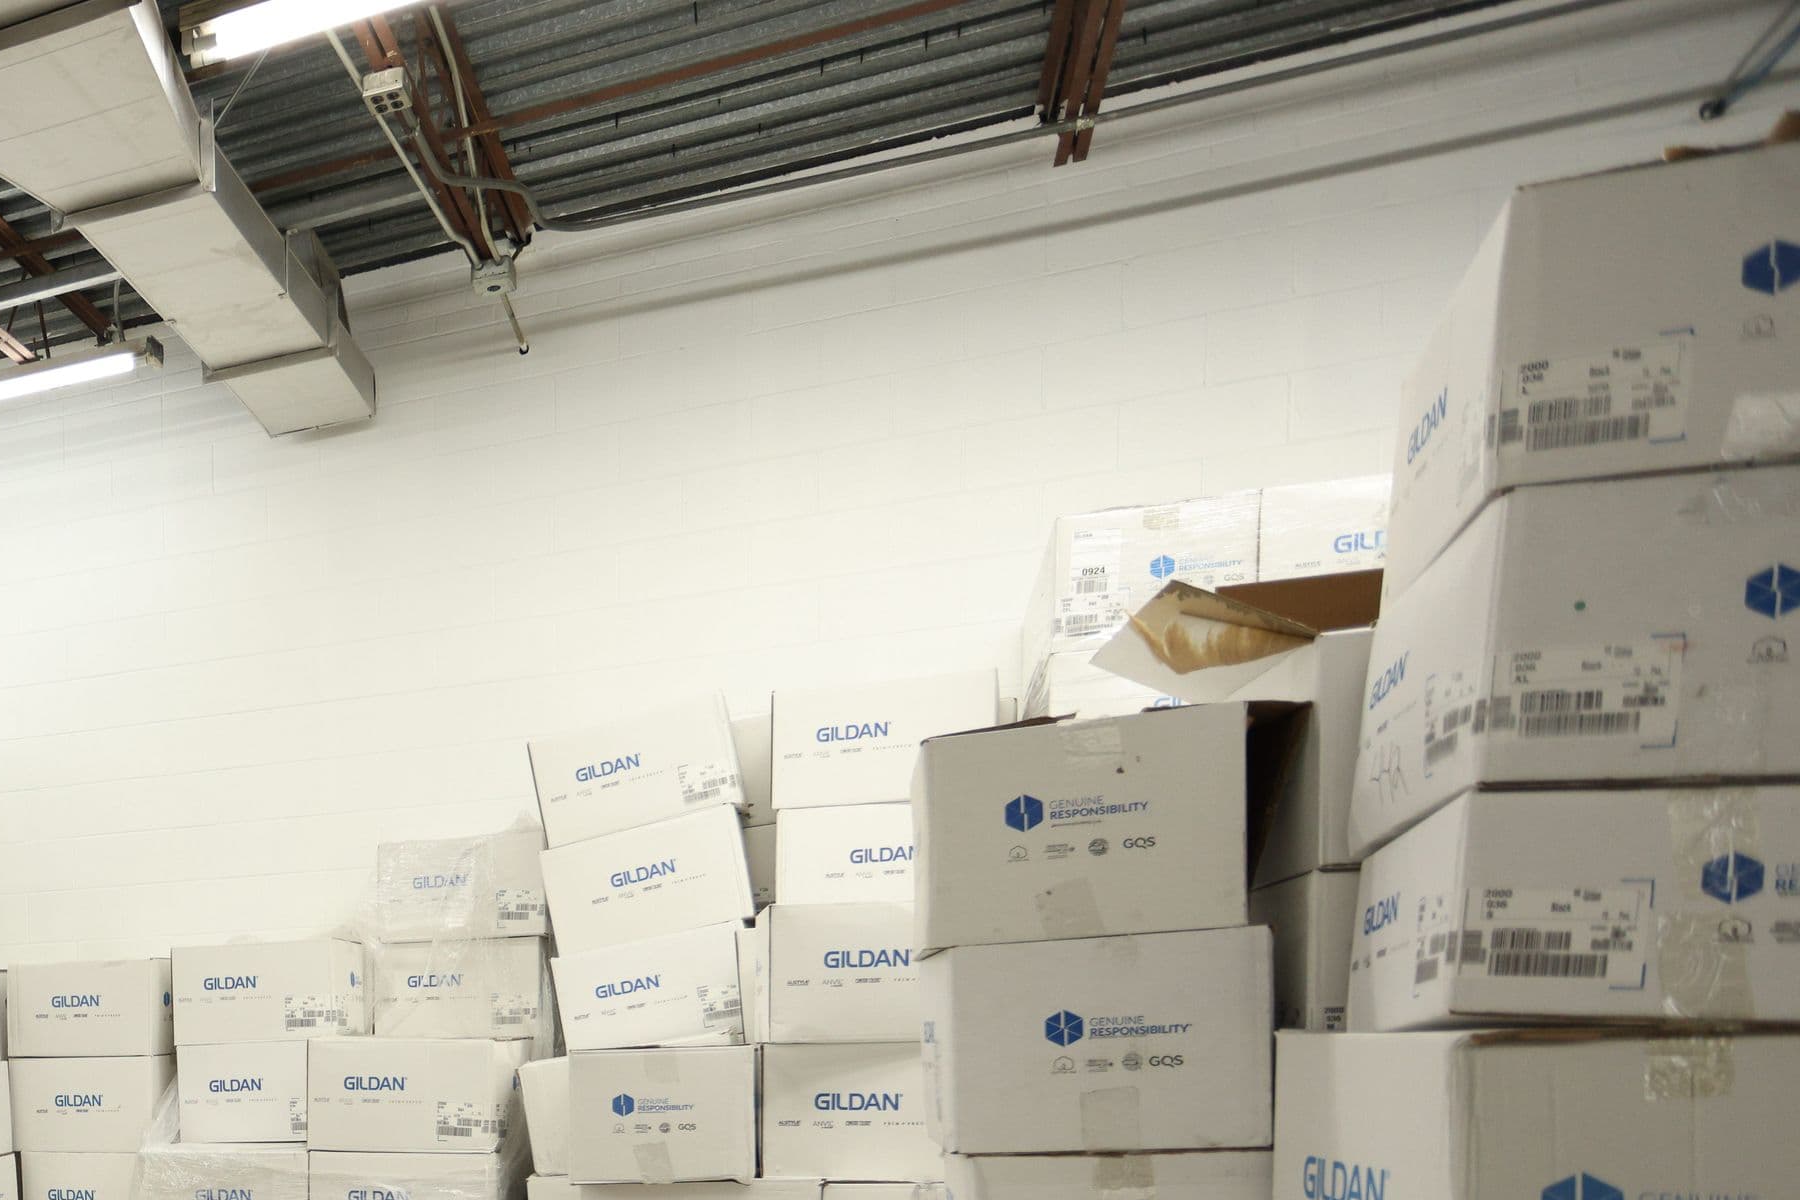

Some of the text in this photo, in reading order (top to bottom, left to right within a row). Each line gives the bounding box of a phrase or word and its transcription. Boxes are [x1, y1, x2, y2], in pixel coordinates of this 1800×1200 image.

[1082, 565, 1105, 576] 0924
[816, 721, 888, 744] GILDAN
[575, 752, 641, 783] GILDAN
[1049, 796, 1104, 808] GENUINE
[1050, 802, 1148, 820] RESPONSIBILITY
[610, 860, 676, 889] GILDAN
[203, 976, 257, 991] GILDAN
[594, 976, 660, 1000] GILDAN
[51, 994, 100, 1008] GILDAN
[1090, 1016, 1144, 1026] GENUINE
[1090, 1024, 1190, 1038] RESPONSIBILITY
[209, 1077, 262, 1093] GILDAN
[344, 1075, 406, 1092] GILDAN
[55, 1093, 102, 1107] GILDAN
[814, 1091, 901, 1112] GILDAN
[48, 1188, 95, 1200] GILDAN
